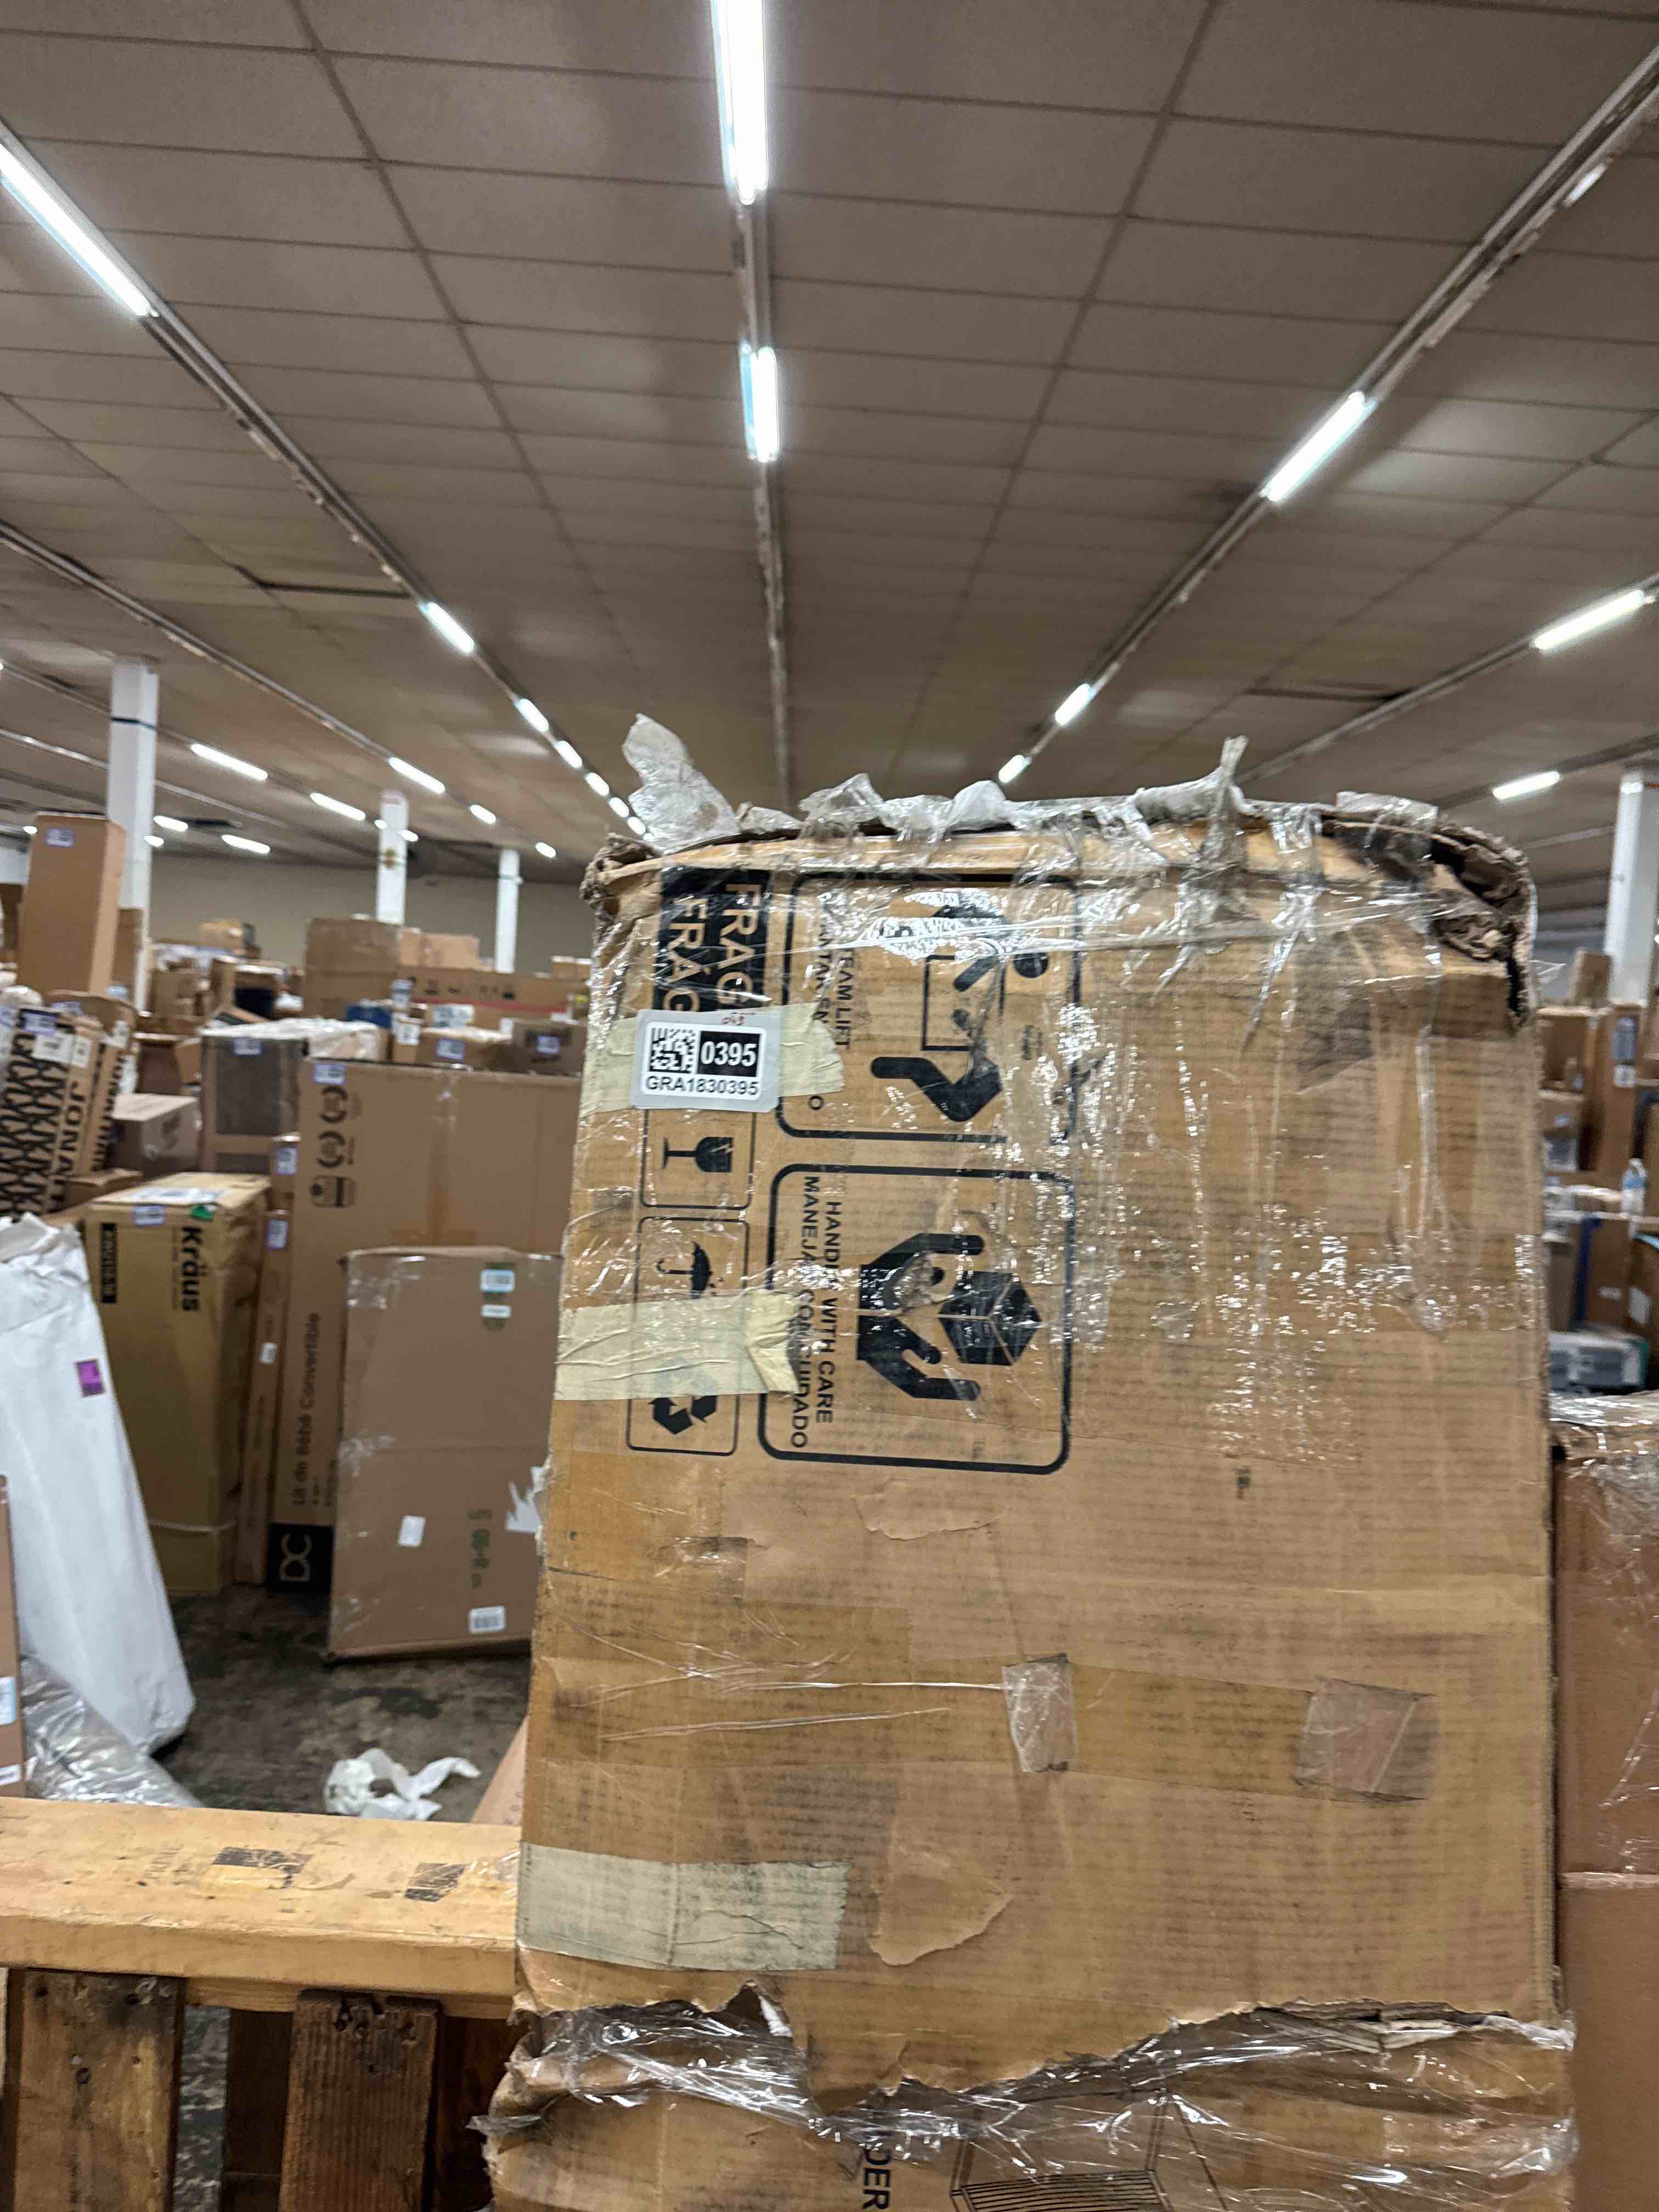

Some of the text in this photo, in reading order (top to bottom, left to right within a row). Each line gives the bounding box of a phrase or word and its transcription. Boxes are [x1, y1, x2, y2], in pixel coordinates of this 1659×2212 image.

[834, 1007, 851, 1050] LIFT
[700, 1041, 757, 1067] 0395
[645, 1075, 760, 1096] GRA1830395
[800, 1176, 820, 1272] MANEJA
[816, 1201, 842, 1423] HANDL WITH CARE
